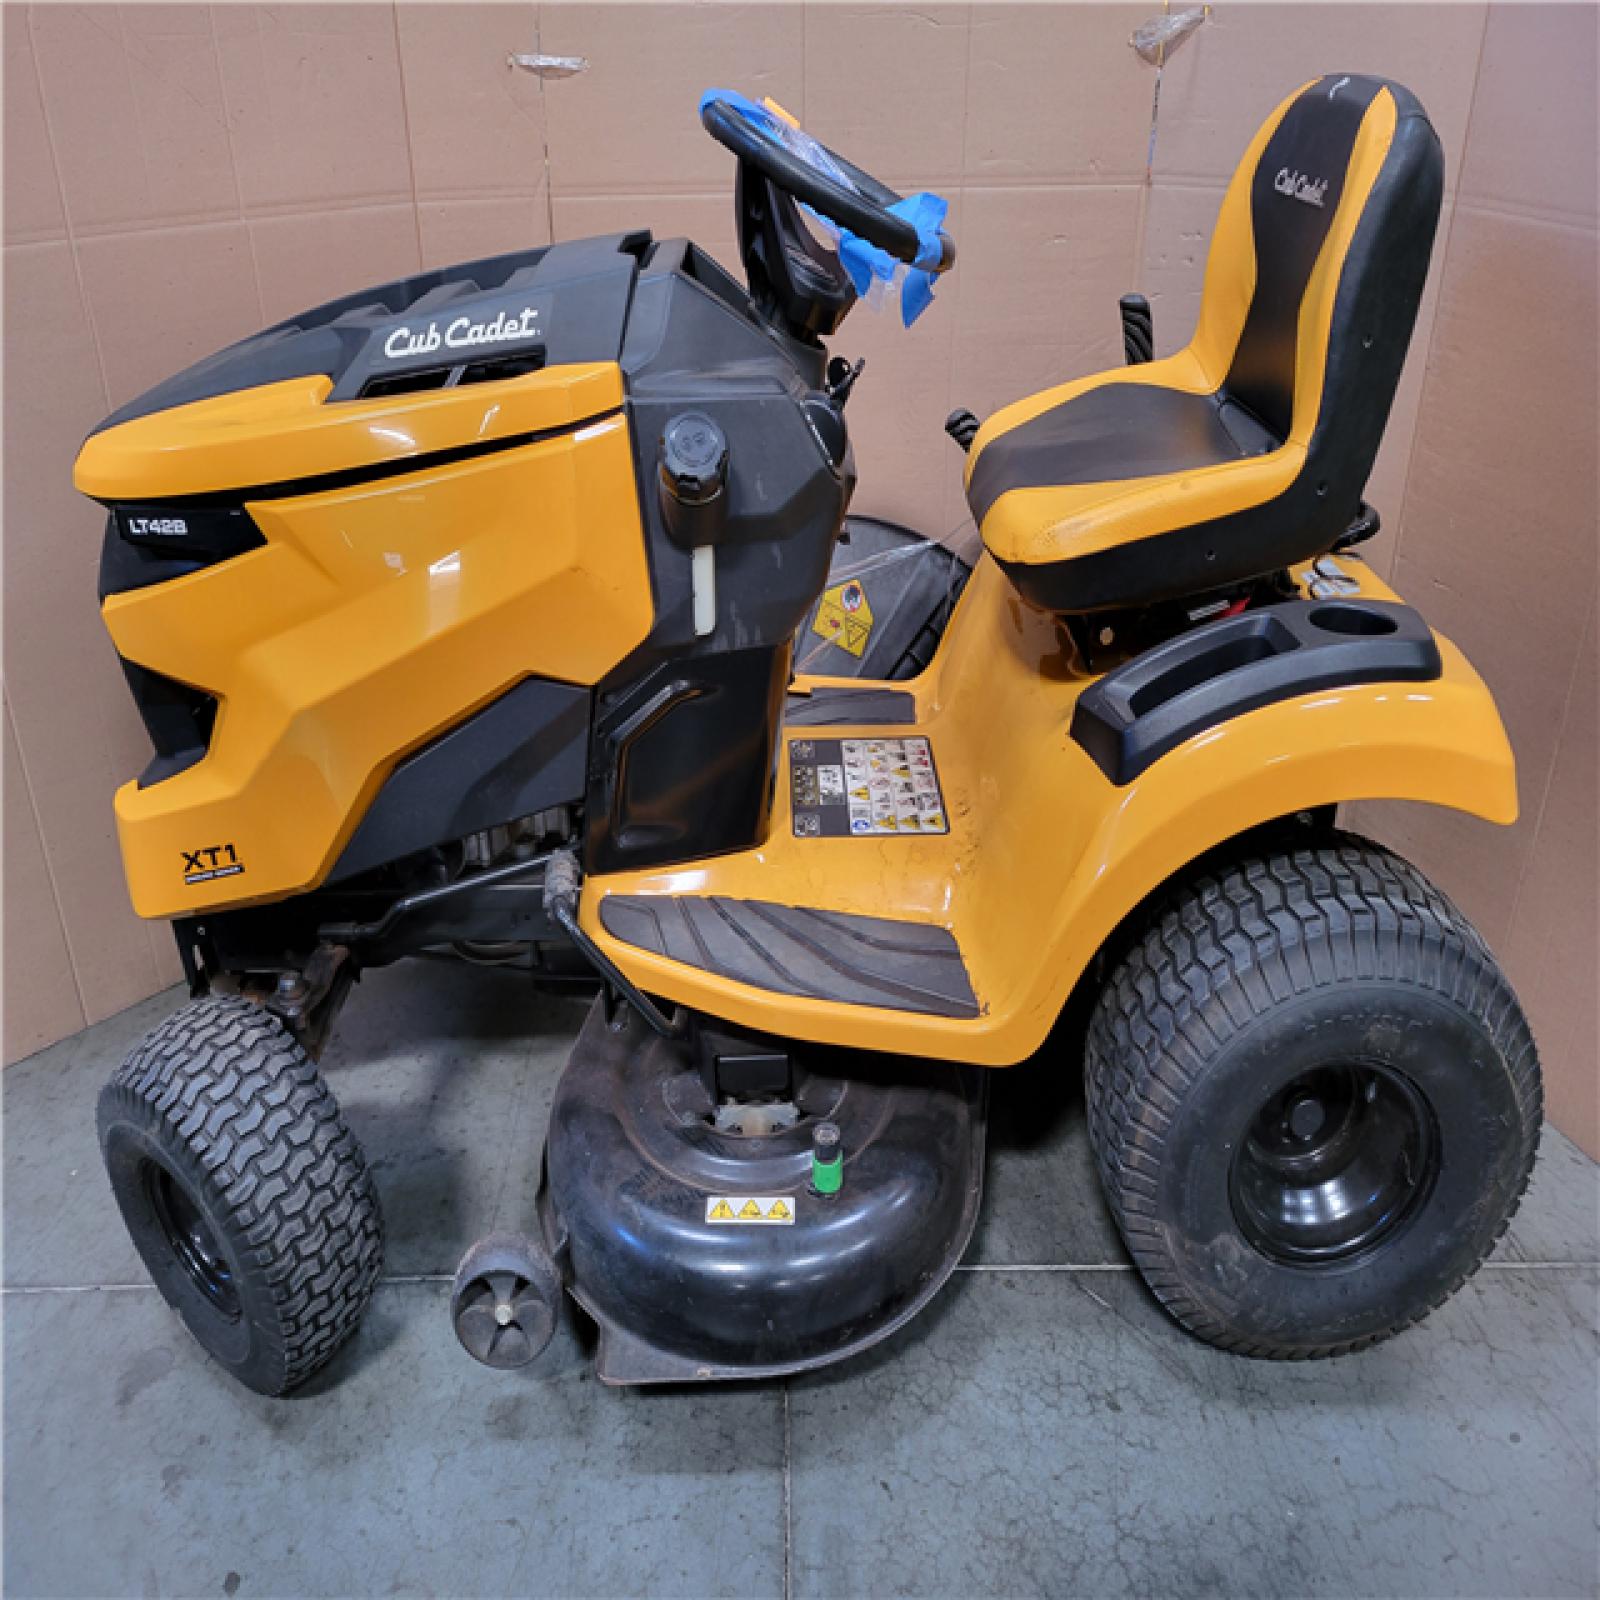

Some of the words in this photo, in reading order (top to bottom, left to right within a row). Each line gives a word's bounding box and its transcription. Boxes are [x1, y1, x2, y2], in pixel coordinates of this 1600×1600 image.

[384, 322, 441, 358] Cub
[445, 306, 539, 348] Cadet
[180, 844, 236, 872] XT1
